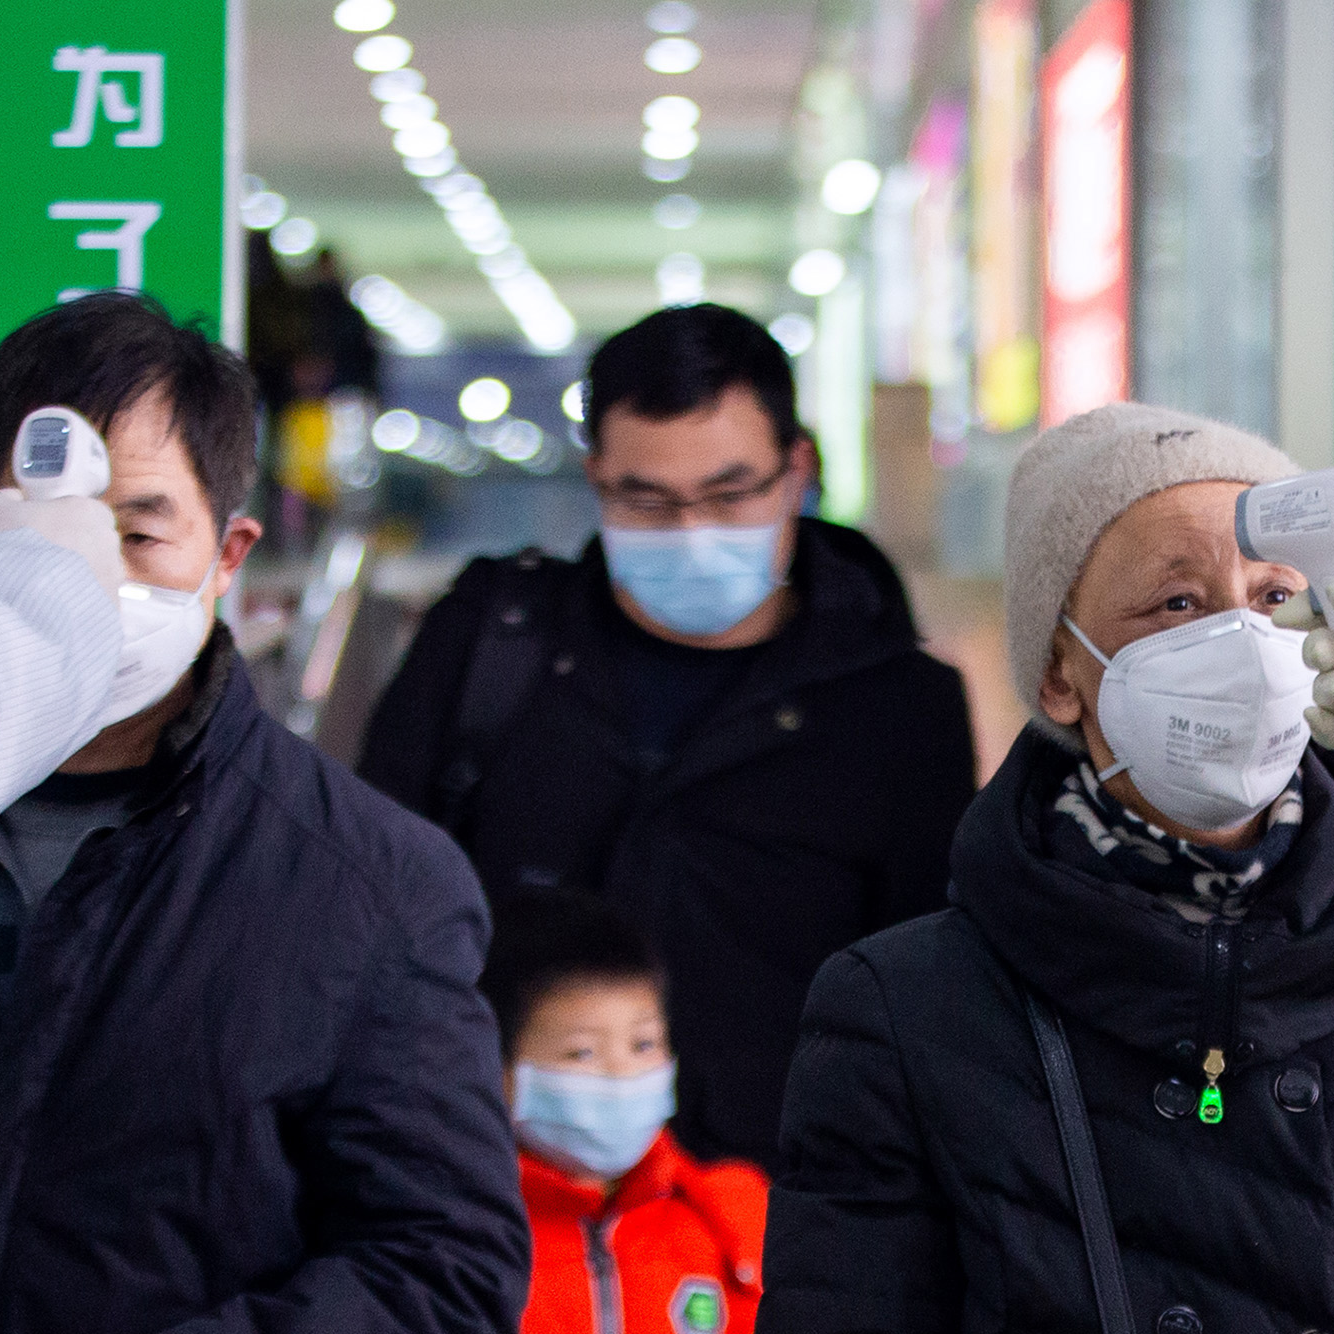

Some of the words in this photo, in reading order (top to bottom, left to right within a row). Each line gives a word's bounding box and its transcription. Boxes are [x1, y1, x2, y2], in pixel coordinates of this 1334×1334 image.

[48, 45, 164, 302] 为了
[1168, 716, 1190, 732] 3M
[1194, 722, 1231, 740] 9002
